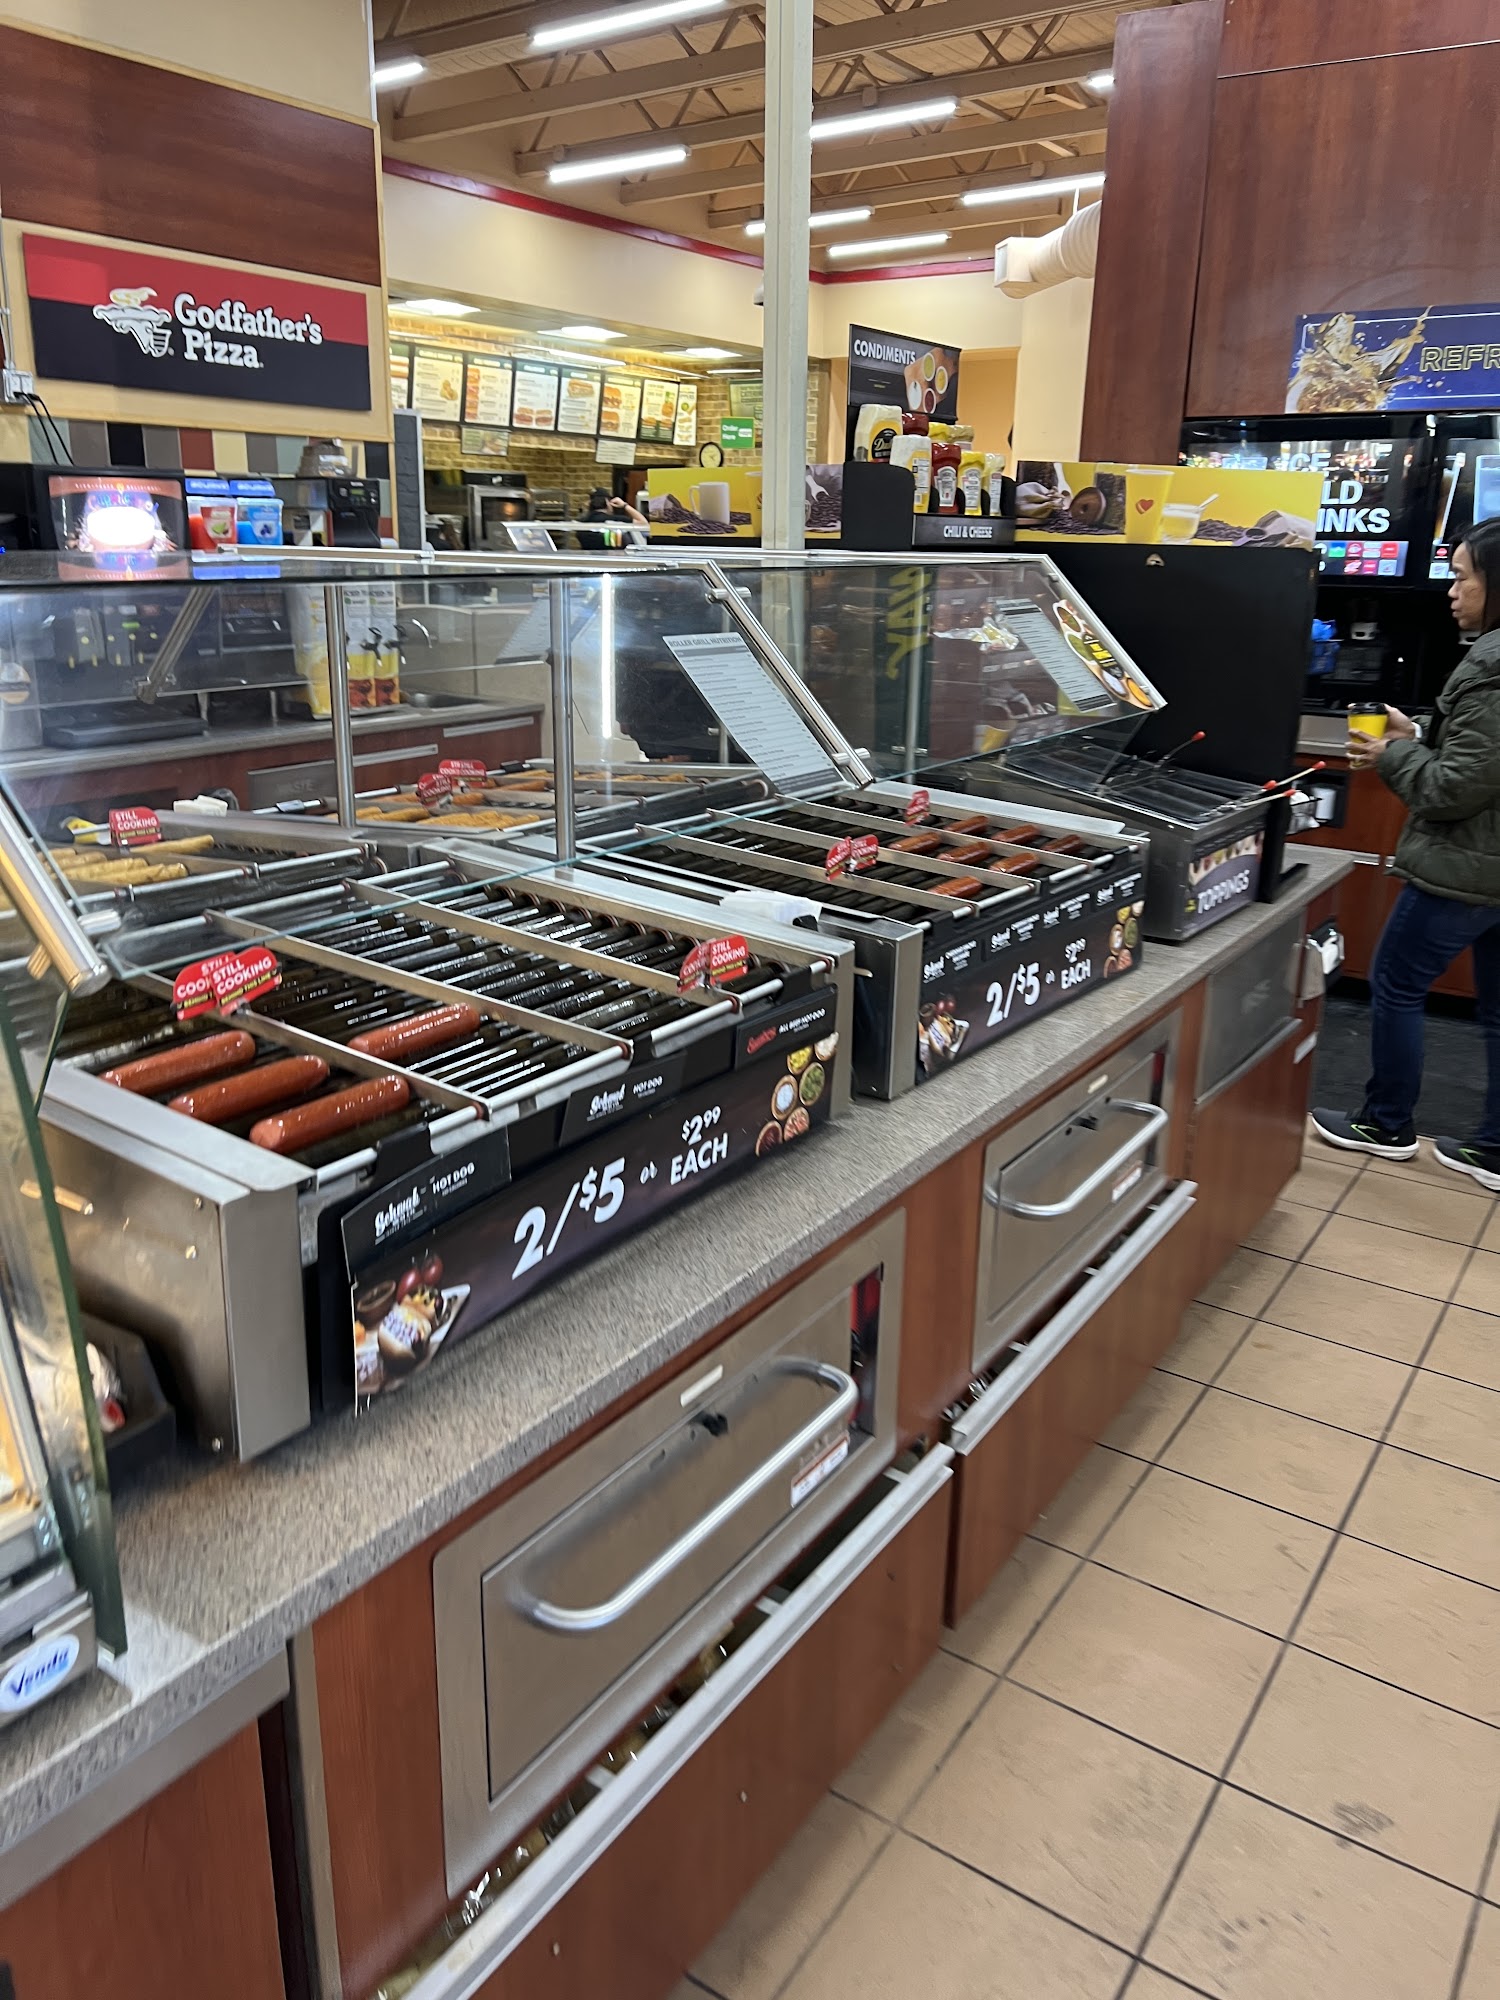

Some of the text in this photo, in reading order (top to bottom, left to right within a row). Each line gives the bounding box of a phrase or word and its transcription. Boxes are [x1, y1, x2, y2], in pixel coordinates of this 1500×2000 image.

[173, 292, 323, 346] Godfather's
[853, 338, 916, 366] CONDIMENTS
[1419, 343, 1500, 372] REFR
[1320, 480, 1364, 505] LD
[943, 525, 993, 539] CHILI & CHEESE
[1315, 507, 1391, 533] INKS
[668, 636, 743, 648] ROLLER GRILL NUTRITION
[115, 810, 138, 821] STILL
[117, 816, 158, 831] COOKING
[1197, 869, 1251, 914] TOPPINGS
[711, 946, 746, 967] COOKING
[712, 939, 732, 954] STILL
[212, 959, 245, 984] STILL
[216, 956, 273, 995] COOKING
[1060, 958, 1092, 991] EACH
[670, 1132, 729, 1186] EACH
[432, 1173, 452, 1195] HOT
[452, 1161, 476, 1183] DOG
[511, 1156, 658, 1280] 2/$5 or
